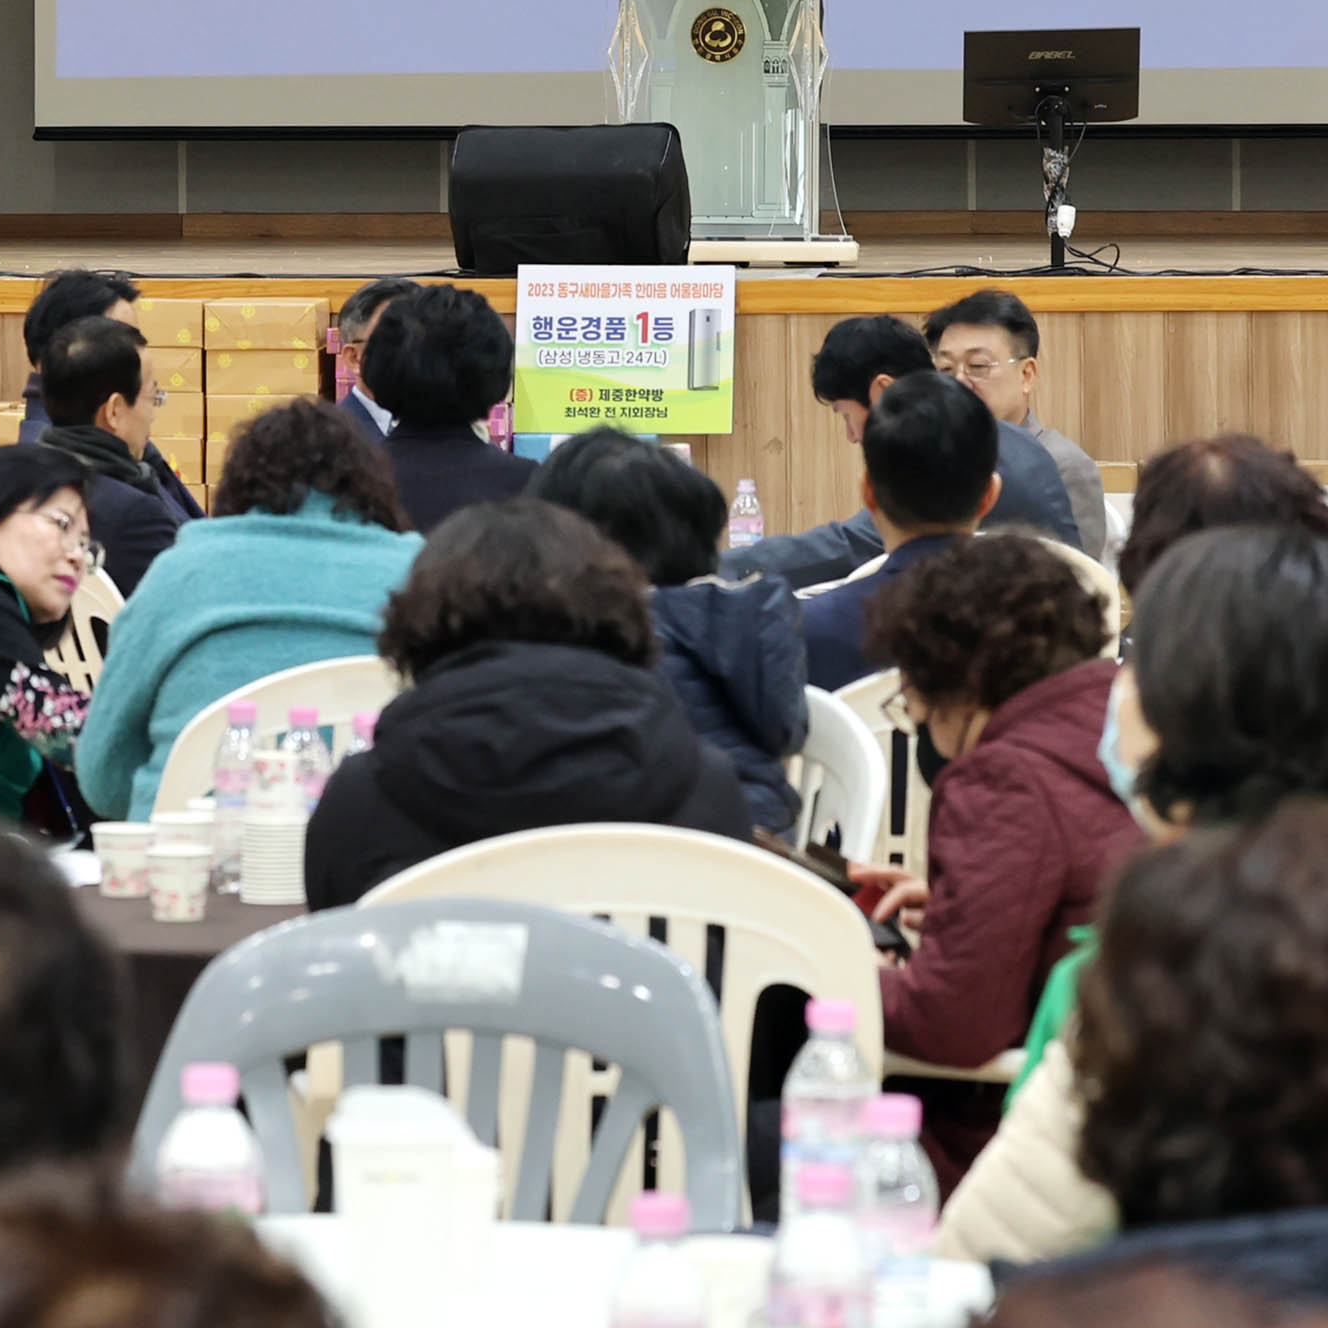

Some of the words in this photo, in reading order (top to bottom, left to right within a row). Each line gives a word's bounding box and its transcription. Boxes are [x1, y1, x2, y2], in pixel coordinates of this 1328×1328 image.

[528, 283, 554, 297] 2023
[558, 282, 632, 299] 동구새마을가족
[671, 282, 724, 299] 어울림마당
[532, 316, 627, 342] 행운경품
[636, 312, 674, 344] 1등
[539, 349, 572, 365] (삼성
[578, 350, 620, 365] 냉동고
[626, 349, 667, 365] 247L)
